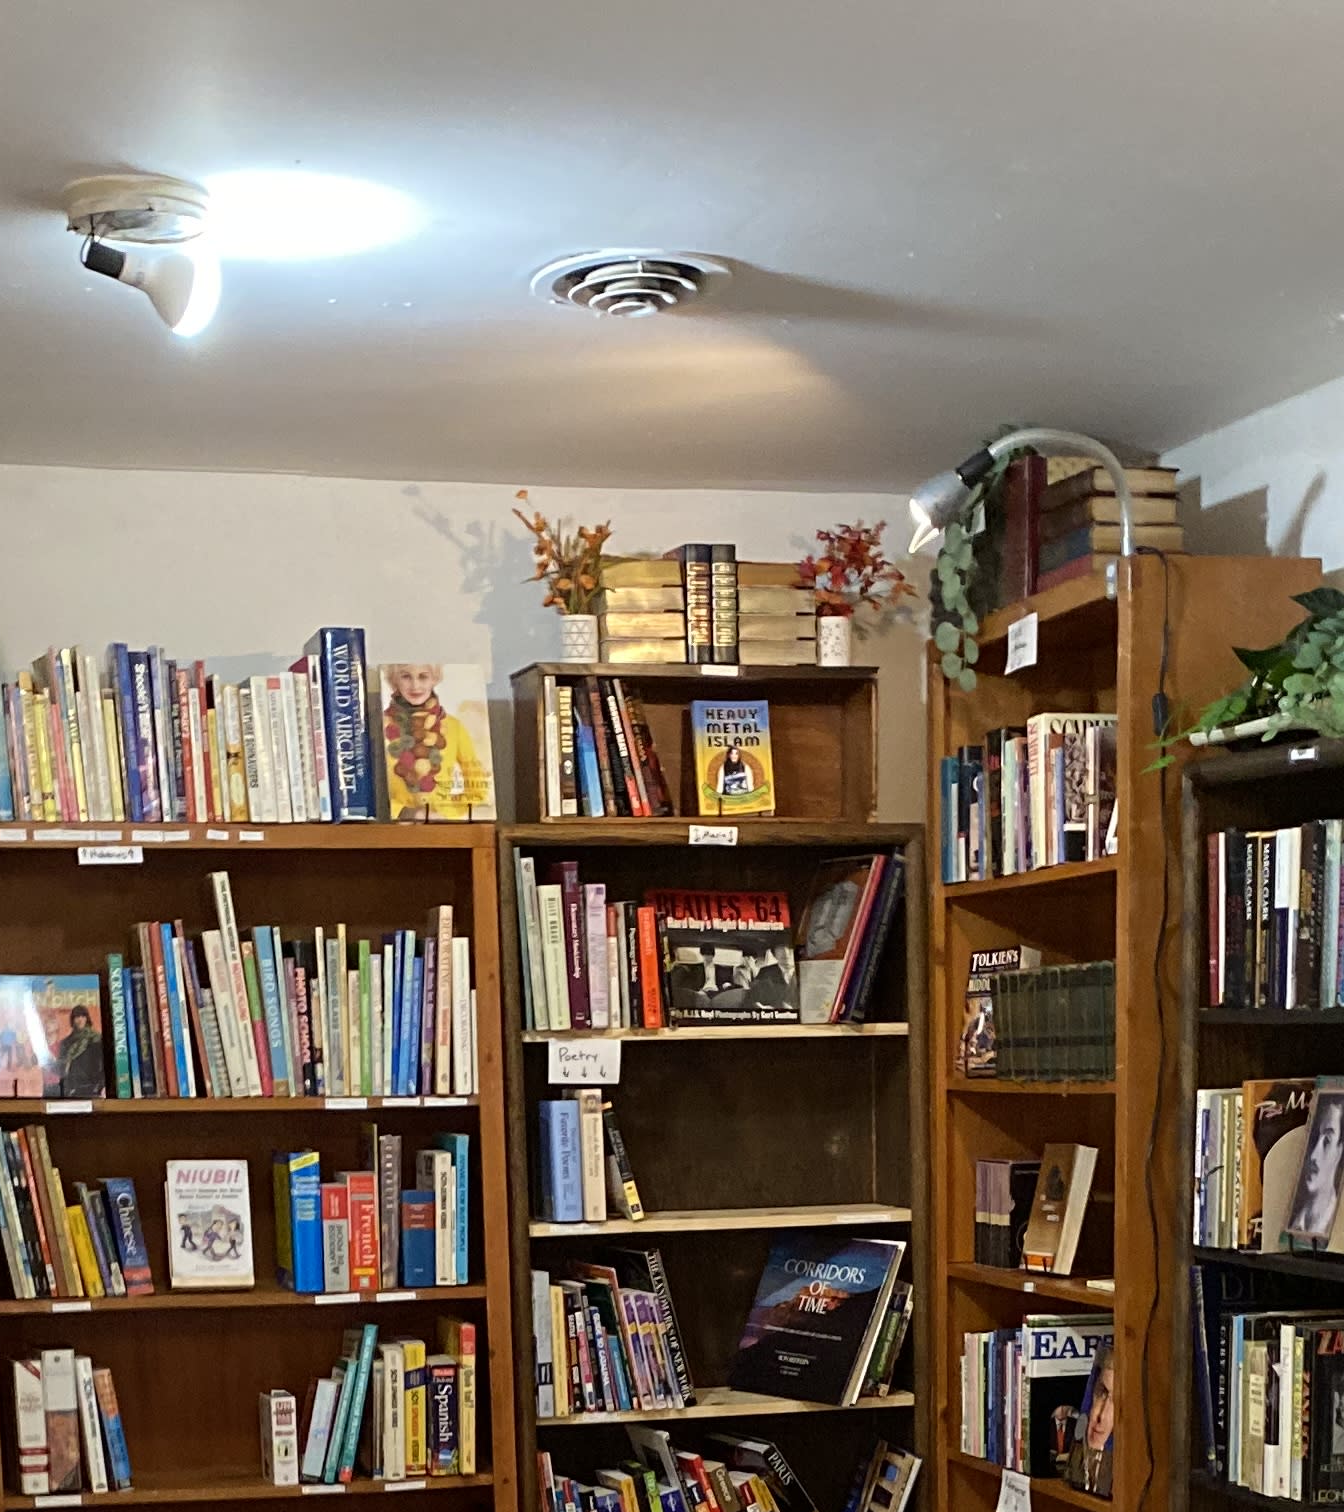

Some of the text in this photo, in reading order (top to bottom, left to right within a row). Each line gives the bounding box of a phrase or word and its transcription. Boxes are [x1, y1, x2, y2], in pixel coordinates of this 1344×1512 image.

[332, 644, 357, 794] WORLD AIRCRAFT
[706, 708, 757, 721] HEAVY
[706, 722, 762, 734] METAL
[707, 735, 761, 748] ISLAM
[1245, 843, 1254, 921] MARCIA CLARK
[1261, 843, 1271, 921] MARCIA CLARK
[657, 893, 782, 923] BEATLES '64
[748, 919, 785, 931] America
[440, 917, 452, 989] DECORATING
[971, 949, 1019, 972] TOLKIEN'S
[109, 968, 127, 1054] SCRAPBOOKING
[261, 958, 282, 1049] BIRD SONGS
[295, 967, 311, 1064] PHOTO SCHOOL
[558, 1046, 598, 1063] Poetry
[176, 1168, 241, 1185] NIUBI!
[561, 1150, 572, 1181] Poems
[116, 1192, 139, 1257] Chinese
[360, 1203, 376, 1266] French
[784, 1258, 867, 1285] CORRIDORS
[809, 1279, 832, 1297] OF
[797, 1295, 831, 1316] TIME
[647, 1253, 691, 1401] THE LANDMARKS OF NEW YORK
[1217, 1325, 1227, 1430] CARY GRANT
[434, 1383, 453, 1443] Spanish
[715, 1468, 733, 1502] Greece
[767, 1450, 793, 1486] PARIS
